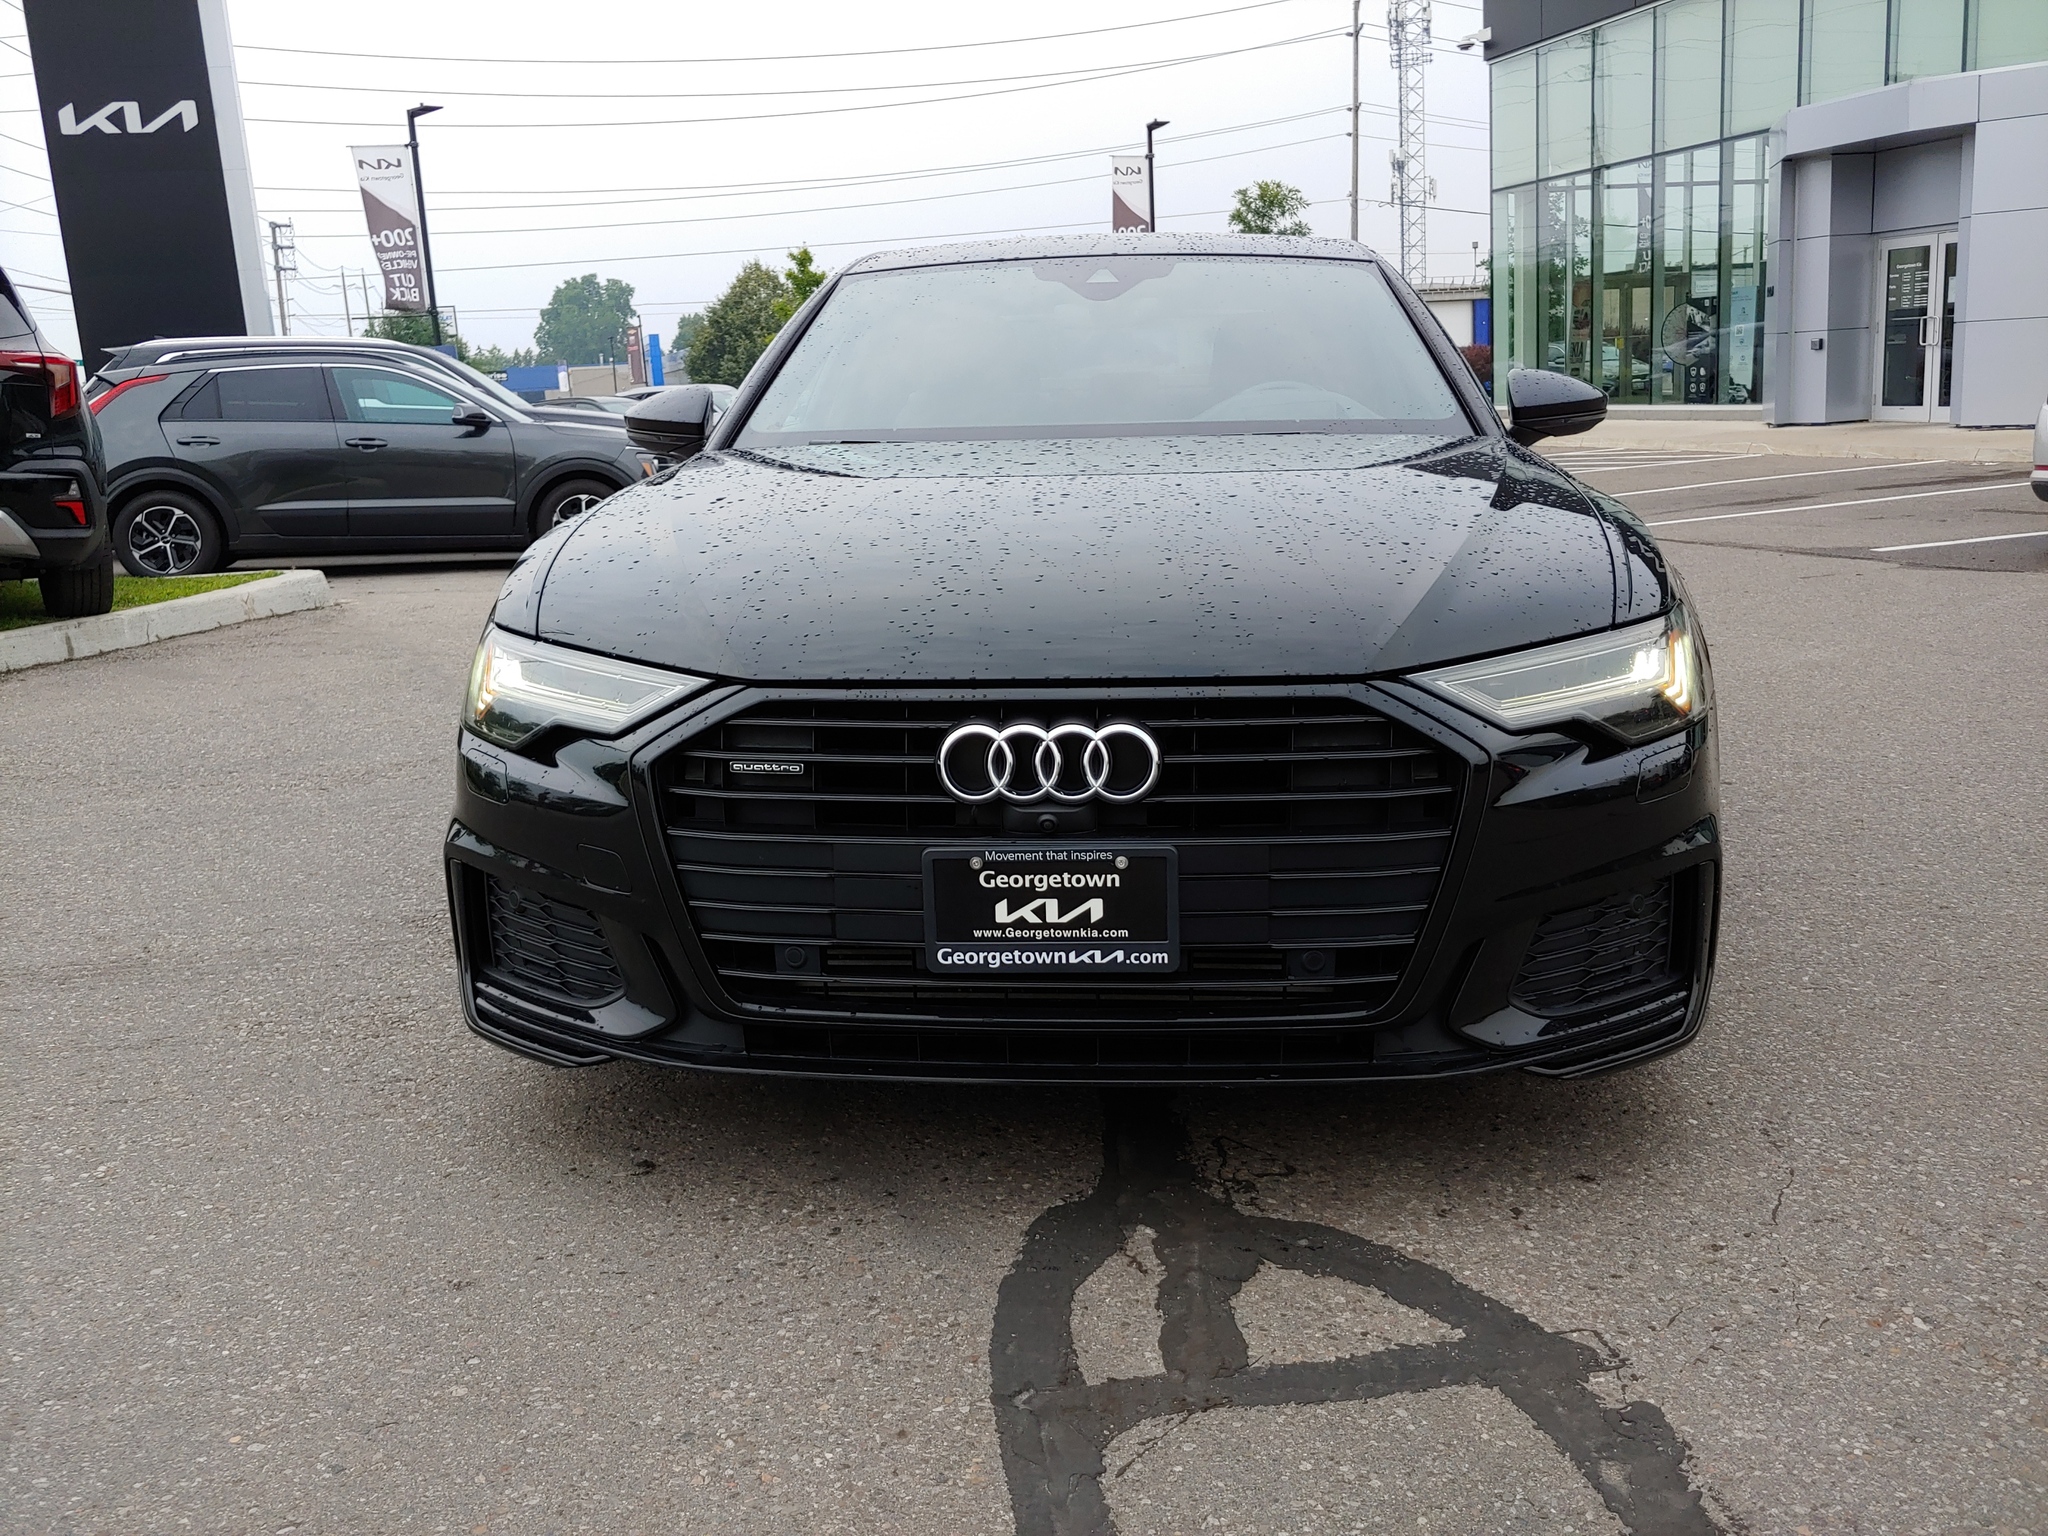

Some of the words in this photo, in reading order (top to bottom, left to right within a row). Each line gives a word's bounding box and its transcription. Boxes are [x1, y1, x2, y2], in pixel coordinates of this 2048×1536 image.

[58, 100, 198, 136] KIA
[732, 763, 800, 772] quattro
[984, 850, 1043, 861] Movement
[1045, 850, 1068, 861] that
[1070, 850, 1113, 862] inspires
[978, 870, 1121, 892] Georgetown
[995, 897, 1104, 924] KIA
[973, 927, 1129, 939] www.Georgetownkia.com
